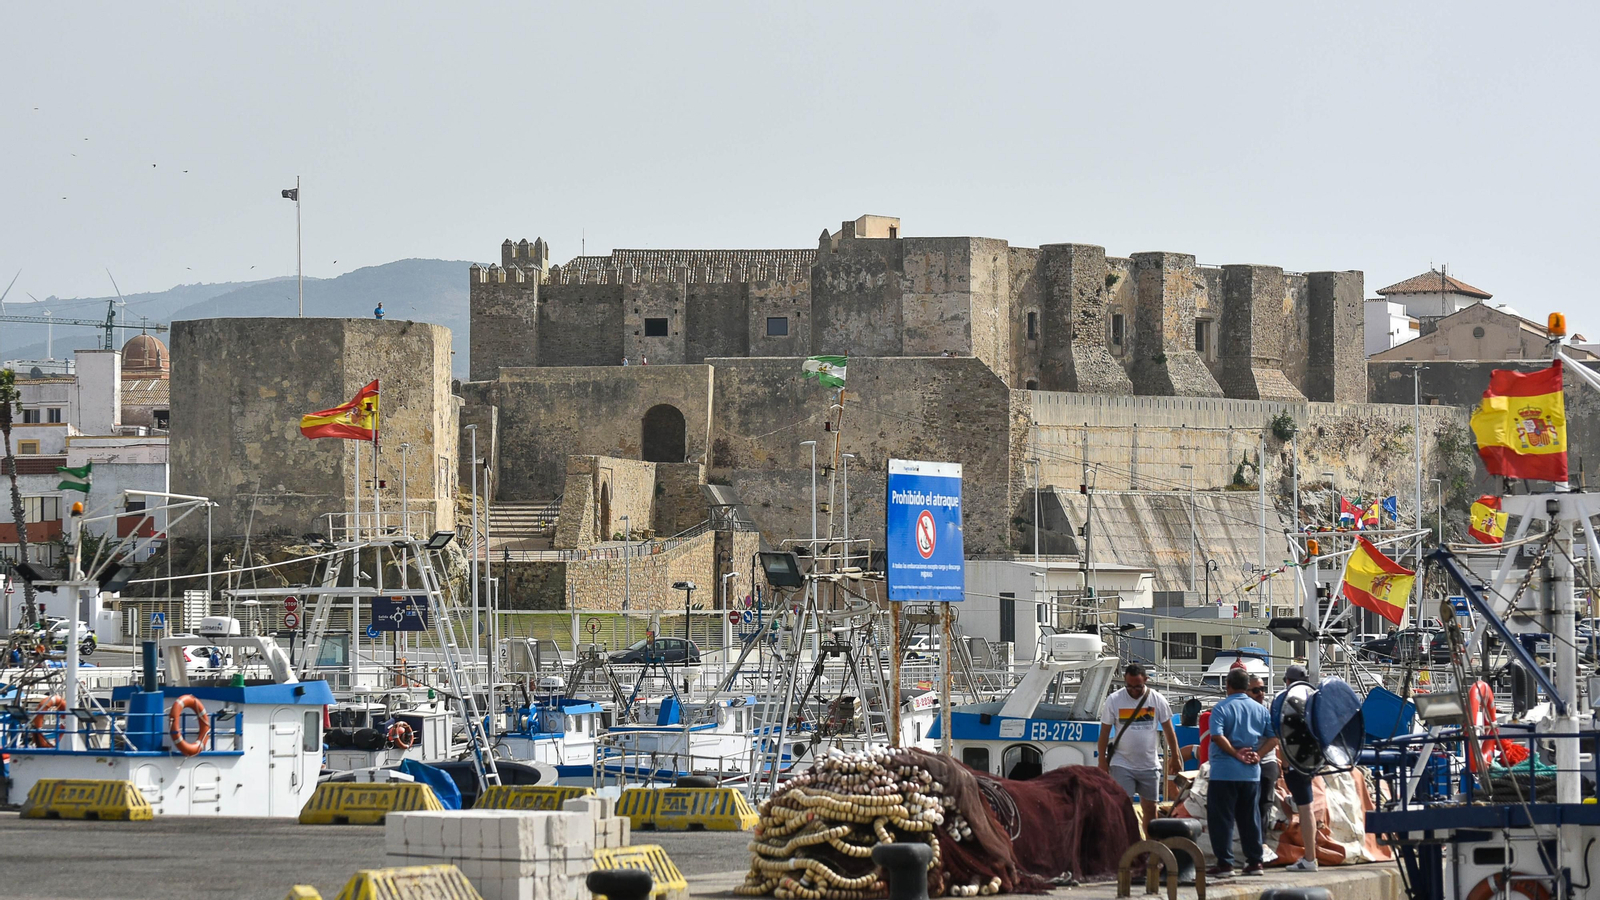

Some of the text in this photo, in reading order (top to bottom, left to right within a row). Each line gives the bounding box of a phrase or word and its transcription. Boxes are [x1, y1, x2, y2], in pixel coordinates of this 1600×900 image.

[892, 490, 959, 510] Prohibido el atraque
[501, 648, 506, 657] 2
[1030, 722, 1083, 741] EB-2729
[661, 797, 689, 810] PAL
